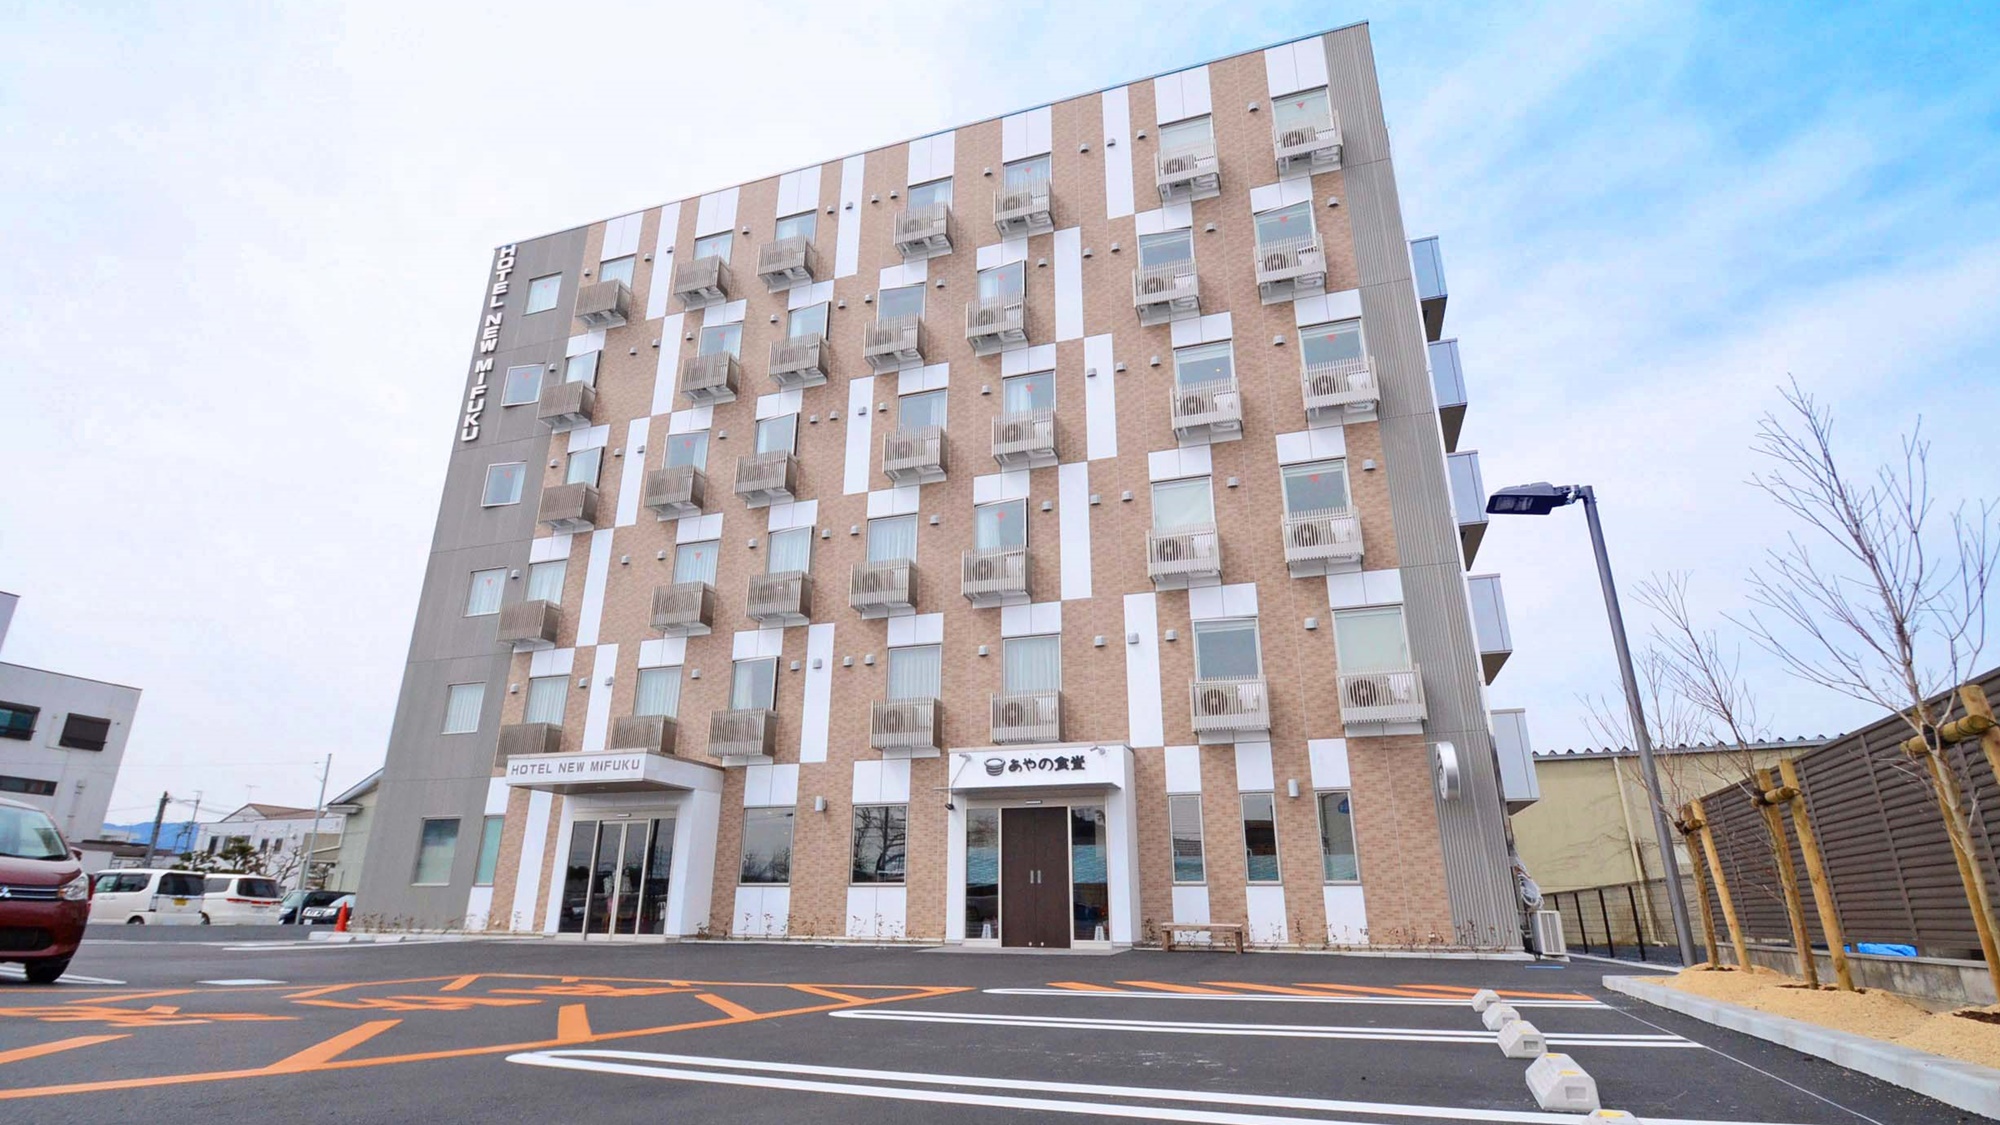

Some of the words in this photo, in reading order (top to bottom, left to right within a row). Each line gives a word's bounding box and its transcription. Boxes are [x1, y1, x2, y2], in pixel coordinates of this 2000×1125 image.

[490, 244, 517, 308] HOTEL
[480, 312, 503, 354] NEW
[461, 357, 494, 442] MIFUKU
[511, 763, 552, 775] HOTEL
[558, 761, 585, 773] NEW
[590, 759, 640, 772] MIFUKU
[1008, 755, 1086, 773] あやの食堂
